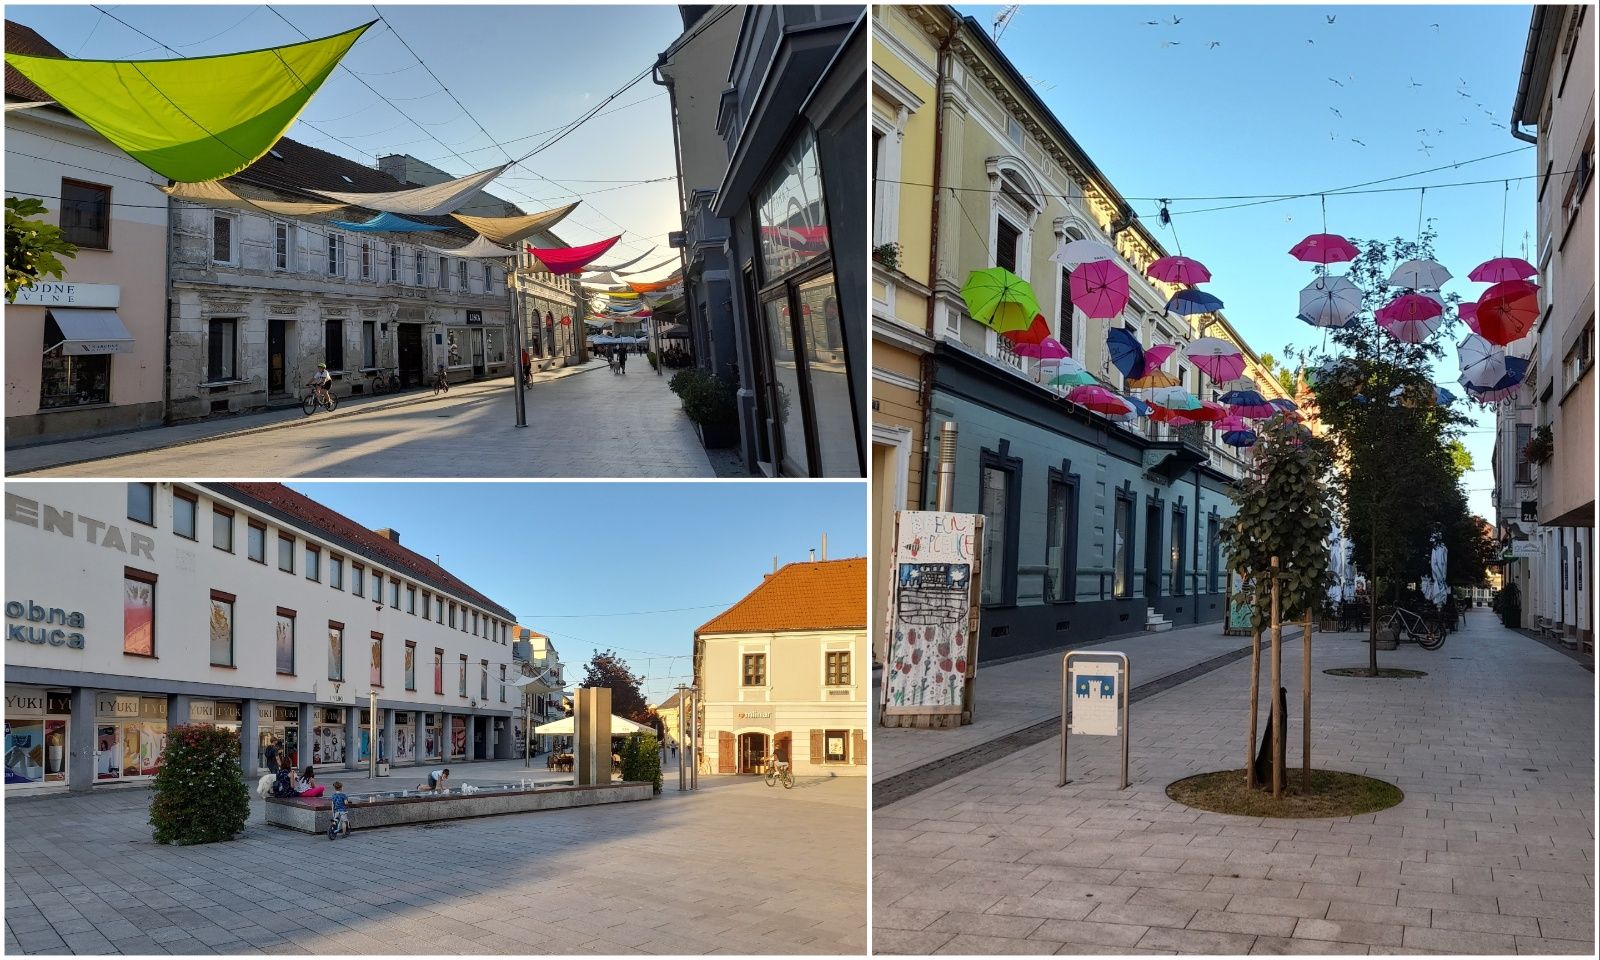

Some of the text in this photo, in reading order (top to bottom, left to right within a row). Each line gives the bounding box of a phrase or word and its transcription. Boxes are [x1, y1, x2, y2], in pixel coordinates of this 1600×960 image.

[5, 491, 155, 562] ENTAR
[5, 599, 85, 629] obna
[5, 694, 43, 708] YUKI
[107, 700, 138, 713] YUKI
[746, 710, 772, 719] mlinar
